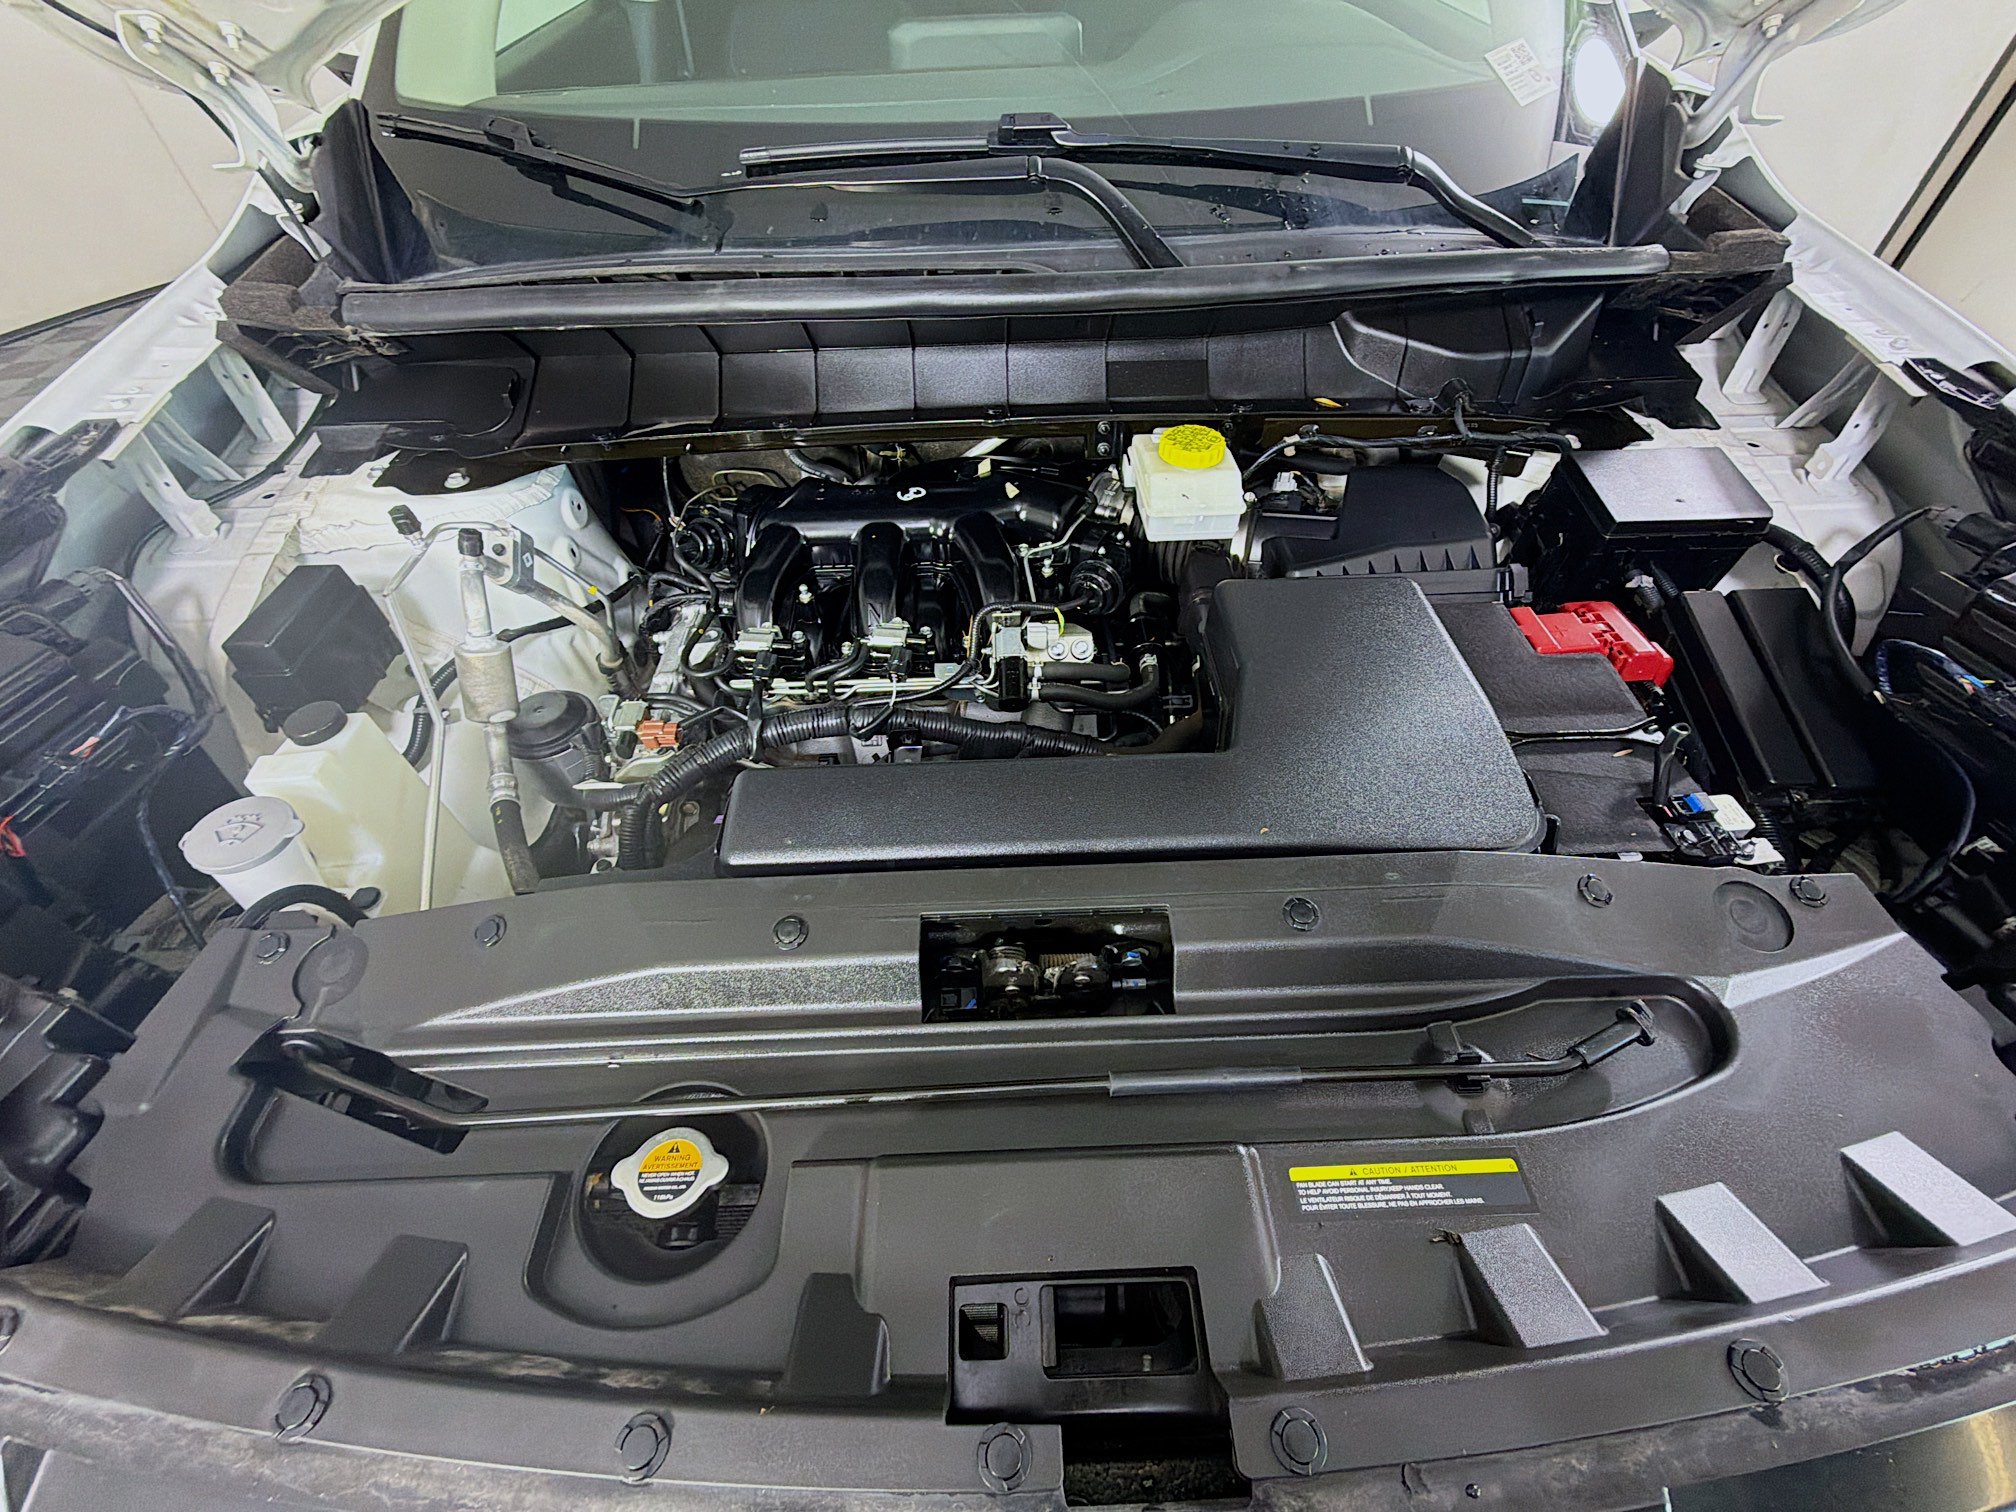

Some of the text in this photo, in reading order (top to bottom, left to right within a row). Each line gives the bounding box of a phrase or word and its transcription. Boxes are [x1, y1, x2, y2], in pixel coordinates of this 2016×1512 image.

[654, 1154, 691, 1162] WARNING
[643, 1162, 698, 1170] AVERTISSEMENT
[1362, 1166, 1401, 1175] CAUTION
[1410, 1164, 1458, 1173] ATTENTION
[1340, 1186, 1370, 1194] PERSONAL
[1308, 1196, 1344, 1204] VENTILATEUR
